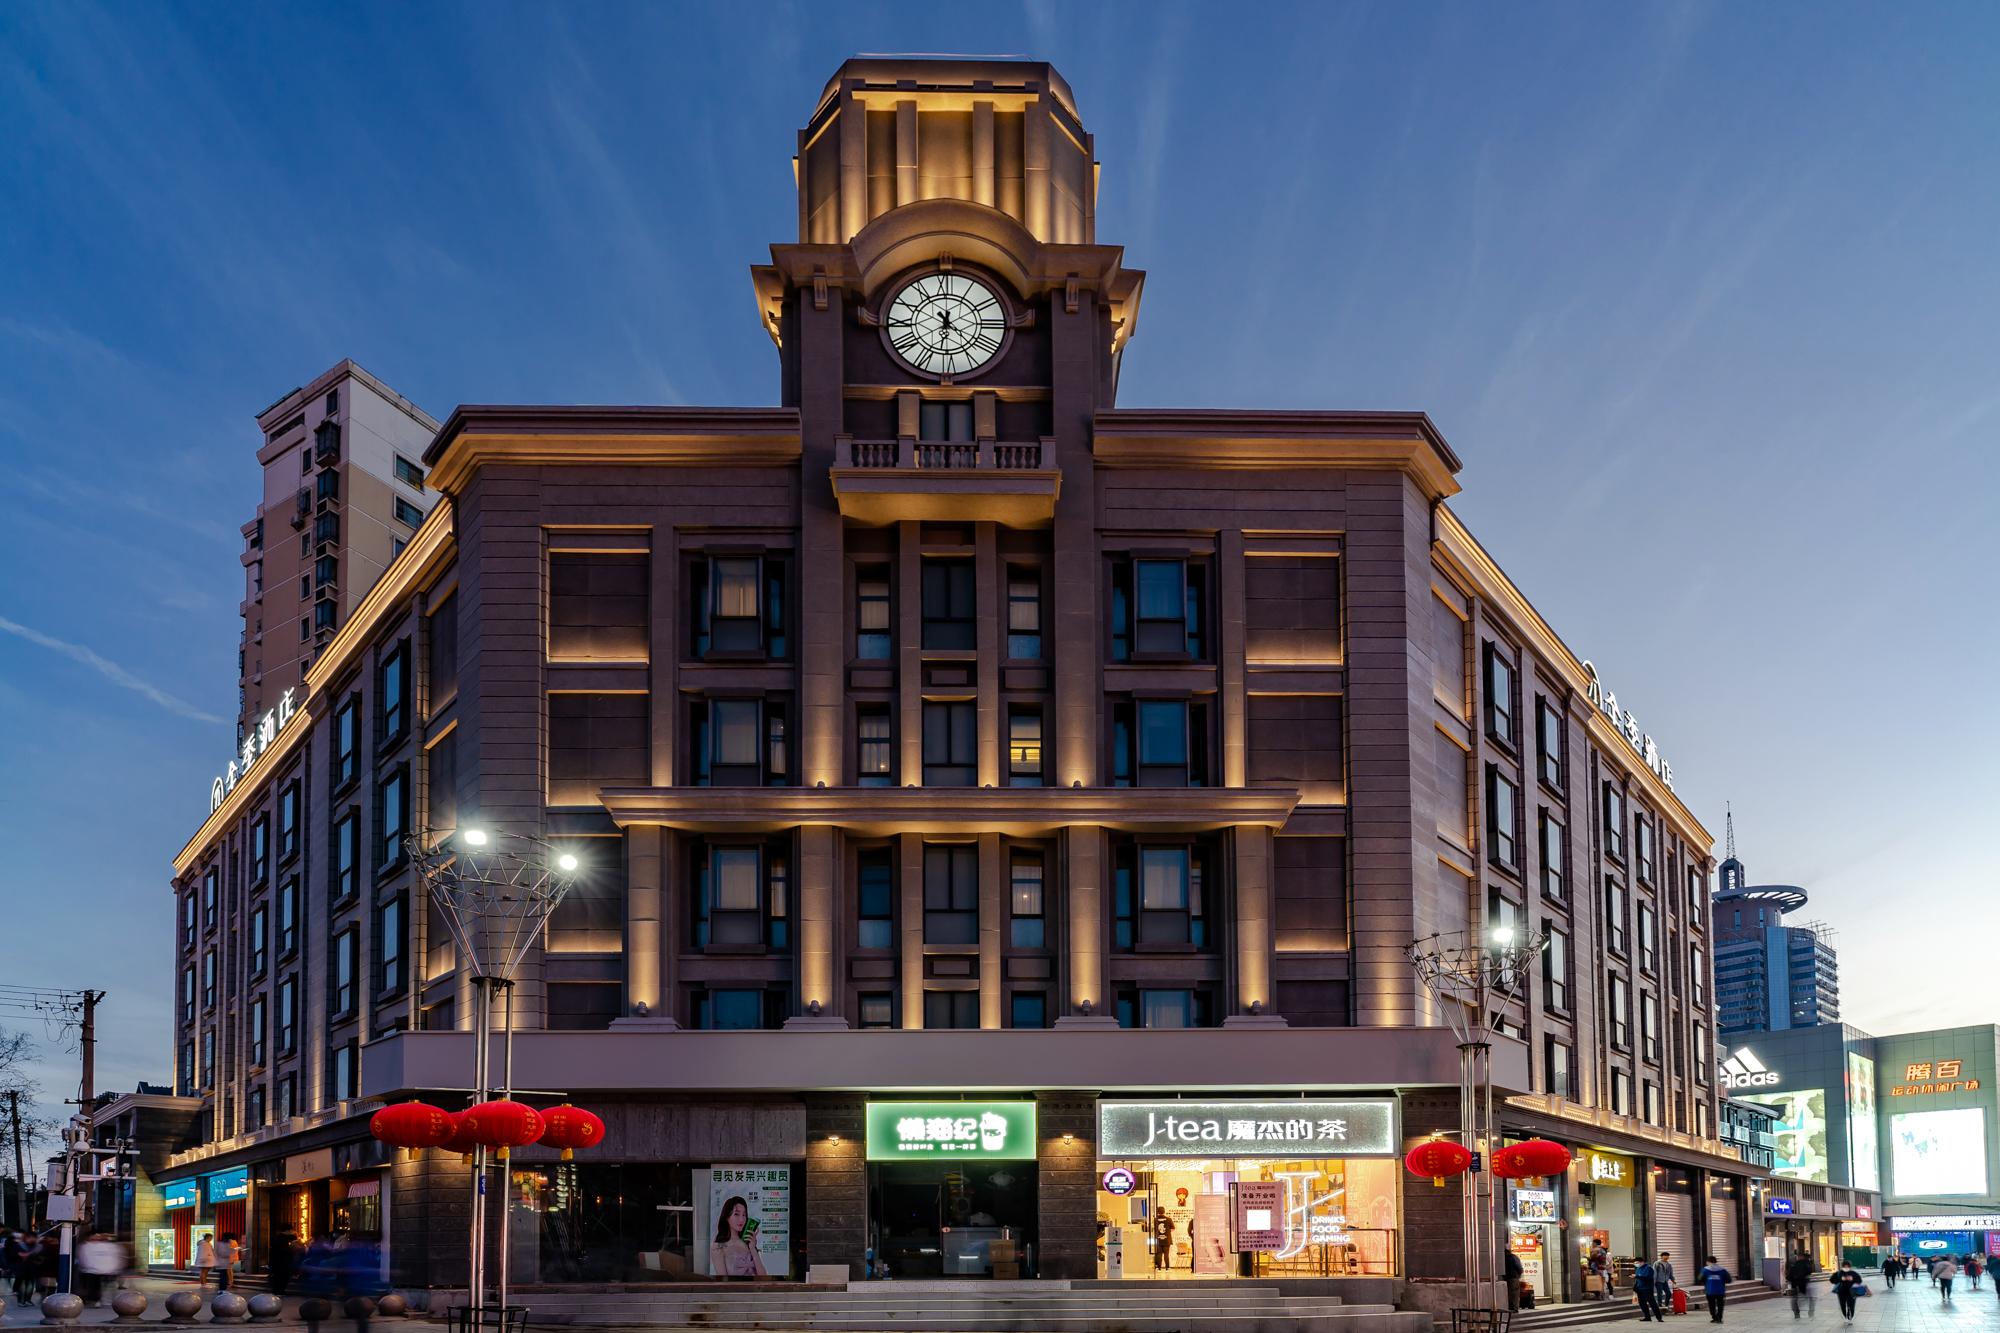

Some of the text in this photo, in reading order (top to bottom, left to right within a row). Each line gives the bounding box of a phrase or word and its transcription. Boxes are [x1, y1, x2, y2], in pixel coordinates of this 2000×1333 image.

[226, 686, 296, 791] 全季酒店
[1906, 1060, 1963, 1081] 腾百
[1720, 1072, 1780, 1089] didas
[1890, 1080, 1981, 1096] 运动休闲广场
[1227, 1119, 1348, 1140] 魔杰的茶
[1311, 1216, 1346, 1224] DRINKS
[1311, 1225, 1341, 1233] FOOD
[1311, 1234, 1351, 1243] GAMING
